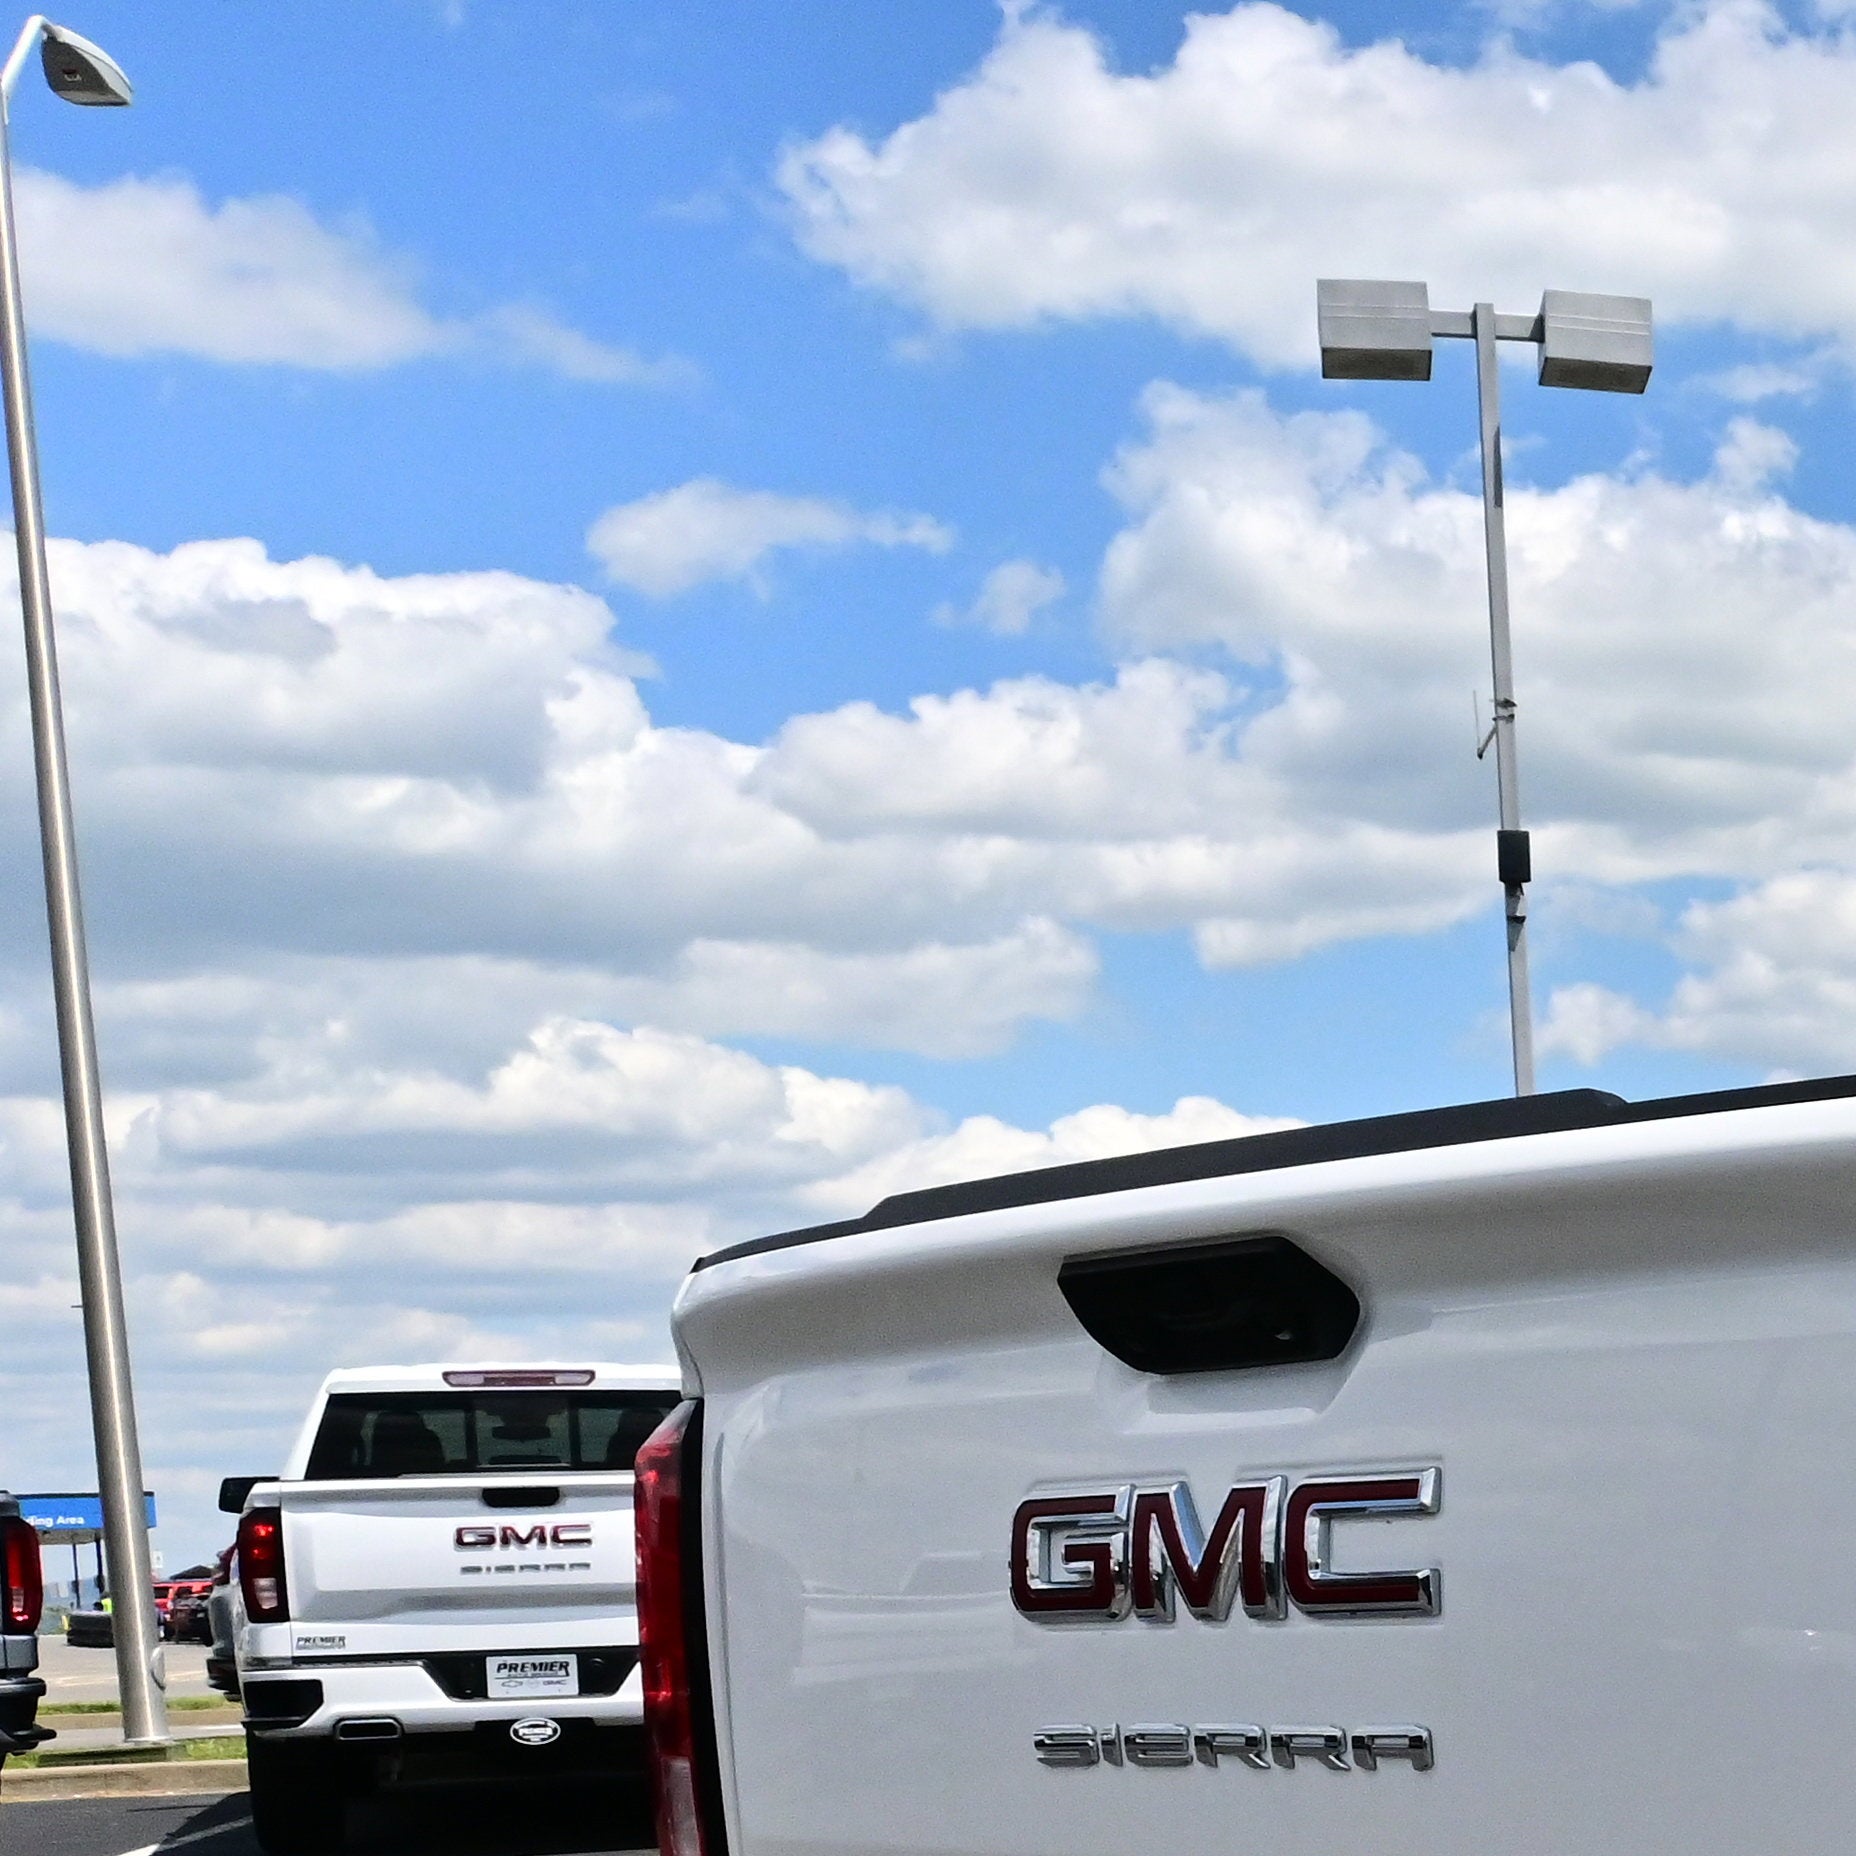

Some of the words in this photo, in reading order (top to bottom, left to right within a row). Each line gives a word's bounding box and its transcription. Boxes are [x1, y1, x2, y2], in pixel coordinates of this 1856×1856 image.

[56, 1515, 85, 1525] Area
[454, 1523, 593, 1552] GMC
[1009, 1465, 1444, 1624] GMC
[496, 1661, 570, 1676] PREMIER
[1032, 1720, 1436, 1773] SIERRA
